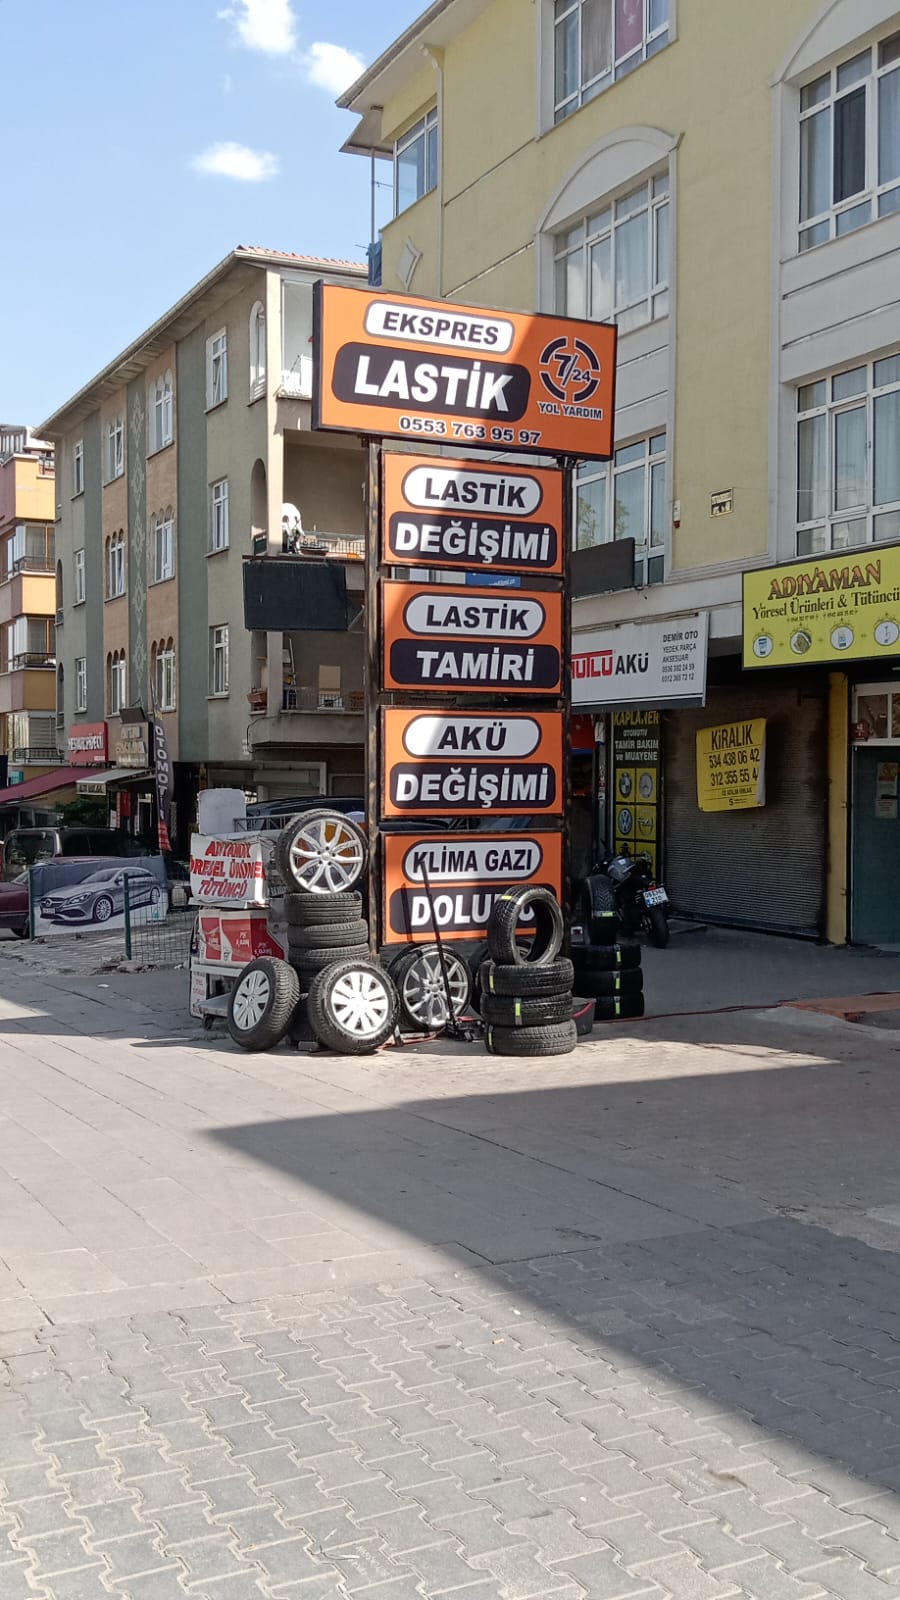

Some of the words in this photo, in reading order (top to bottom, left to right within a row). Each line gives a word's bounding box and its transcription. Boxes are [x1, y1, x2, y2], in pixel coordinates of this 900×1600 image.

[382, 310, 499, 345] EKSPRES
[353, 354, 514, 413] LASTİK
[537, 401, 561, 415] YOL
[561, 404, 603, 421] YARDIM
[399, 416, 447, 435] 0553
[451, 422, 487, 440] 763
[491, 426, 515, 443] 95
[518, 430, 542, 446] 97
[424, 477, 528, 508] LASTİK
[394, 519, 550, 564] DEĞİŞİMİ
[768, 559, 882, 601] ADIYAMAN
[425, 602, 530, 631] LASTİK
[752, 602, 788, 620] Yöresel
[790, 596, 835, 615] Ürünleri
[837, 594, 848, 609] &
[662, 631, 683, 643] DEMİR
[684, 630, 699, 640] OTO
[416, 646, 535, 681] TAMİRİ
[615, 652, 649, 676] AKÜ
[437, 721, 508, 752] AKÜ
[614, 738, 636, 750] TAMİR
[636, 739, 659, 749] BAKIM
[615, 753, 624, 761] ve
[624, 751, 658, 761] MUAYENE
[708, 754, 722, 769] 534
[722, 751, 737, 766] 438
[737, 749, 748, 765] 06
[749, 747, 761, 763] 42
[395, 766, 549, 809] DEĞİŞİMİ
[710, 771, 724, 787] 312
[723, 769, 738, 785] 355
[739, 767, 750, 783] 55
[413, 845, 479, 874] KLİMA
[484, 848, 534, 872] GAZI
